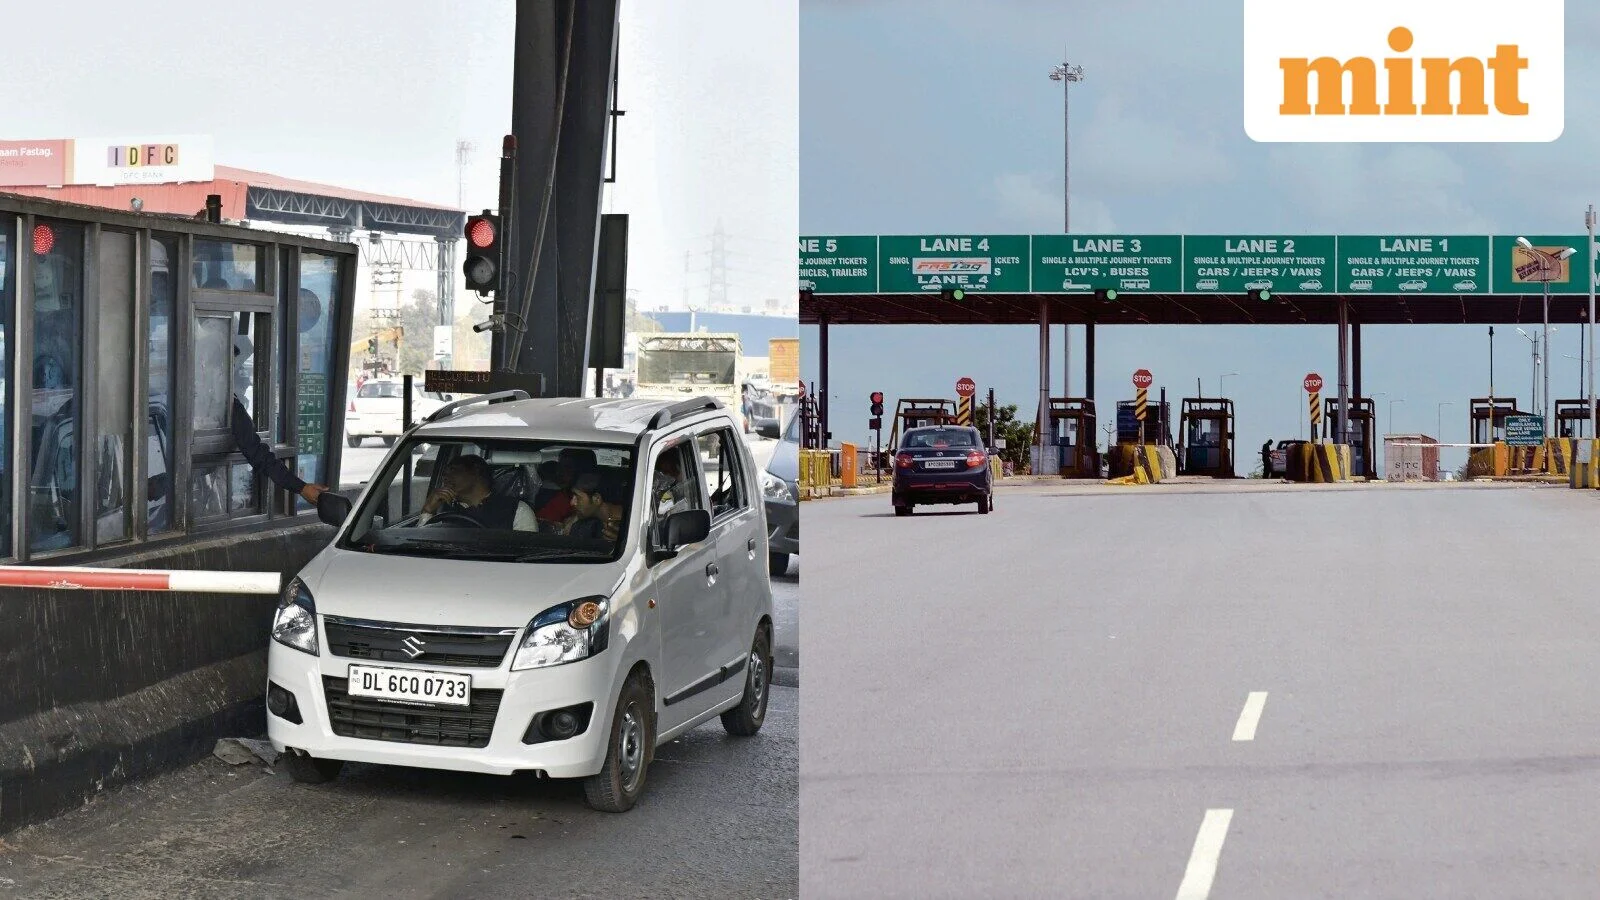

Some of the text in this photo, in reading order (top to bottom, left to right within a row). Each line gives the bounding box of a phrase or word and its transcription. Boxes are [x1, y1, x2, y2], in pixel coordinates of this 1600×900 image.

[20, 147, 53, 158] Fastag.
[114, 146, 174, 166] IDFC
[825, 239, 838, 253] 5
[920, 238, 990, 252] LANE 4
[1072, 239, 1142, 253] LANE 3
[1225, 239, 1295, 253] LANE 2
[1380, 238, 1448, 252] LANE 1
[805, 257, 837, 265] JOURNEY
[838, 257, 868, 265] TICKETS
[1041, 256, 1172, 264] SINGLE & MULTIPLE JOURNEY TICKETS
[1193, 256, 1326, 265] SINGLE & MULTIPLE JOURNEY TICKETS
[1347, 257, 1480, 265] SINGLE & MULTIPLE JOURNEY TICKETS
[831, 268, 868, 277] TRAILERS
[1064, 267, 1099, 276] LCV'S
[1110, 267, 1149, 276] BUSES
[1197, 267, 1230, 277] CARS
[1240, 267, 1279, 277] JEEPS
[1289, 267, 1322, 277] VANS
[1351, 268, 1384, 277] CARS
[1394, 268, 1433, 277] JEEPS
[1443, 268, 1477, 277] VANS
[917, 275, 989, 284] LANE 4
[1133, 374, 1152, 383] STOP
[1304, 379, 1322, 387] STOP
[957, 383, 975, 391] STOP
[363, 672, 466, 698] DL 6CQ 0733
